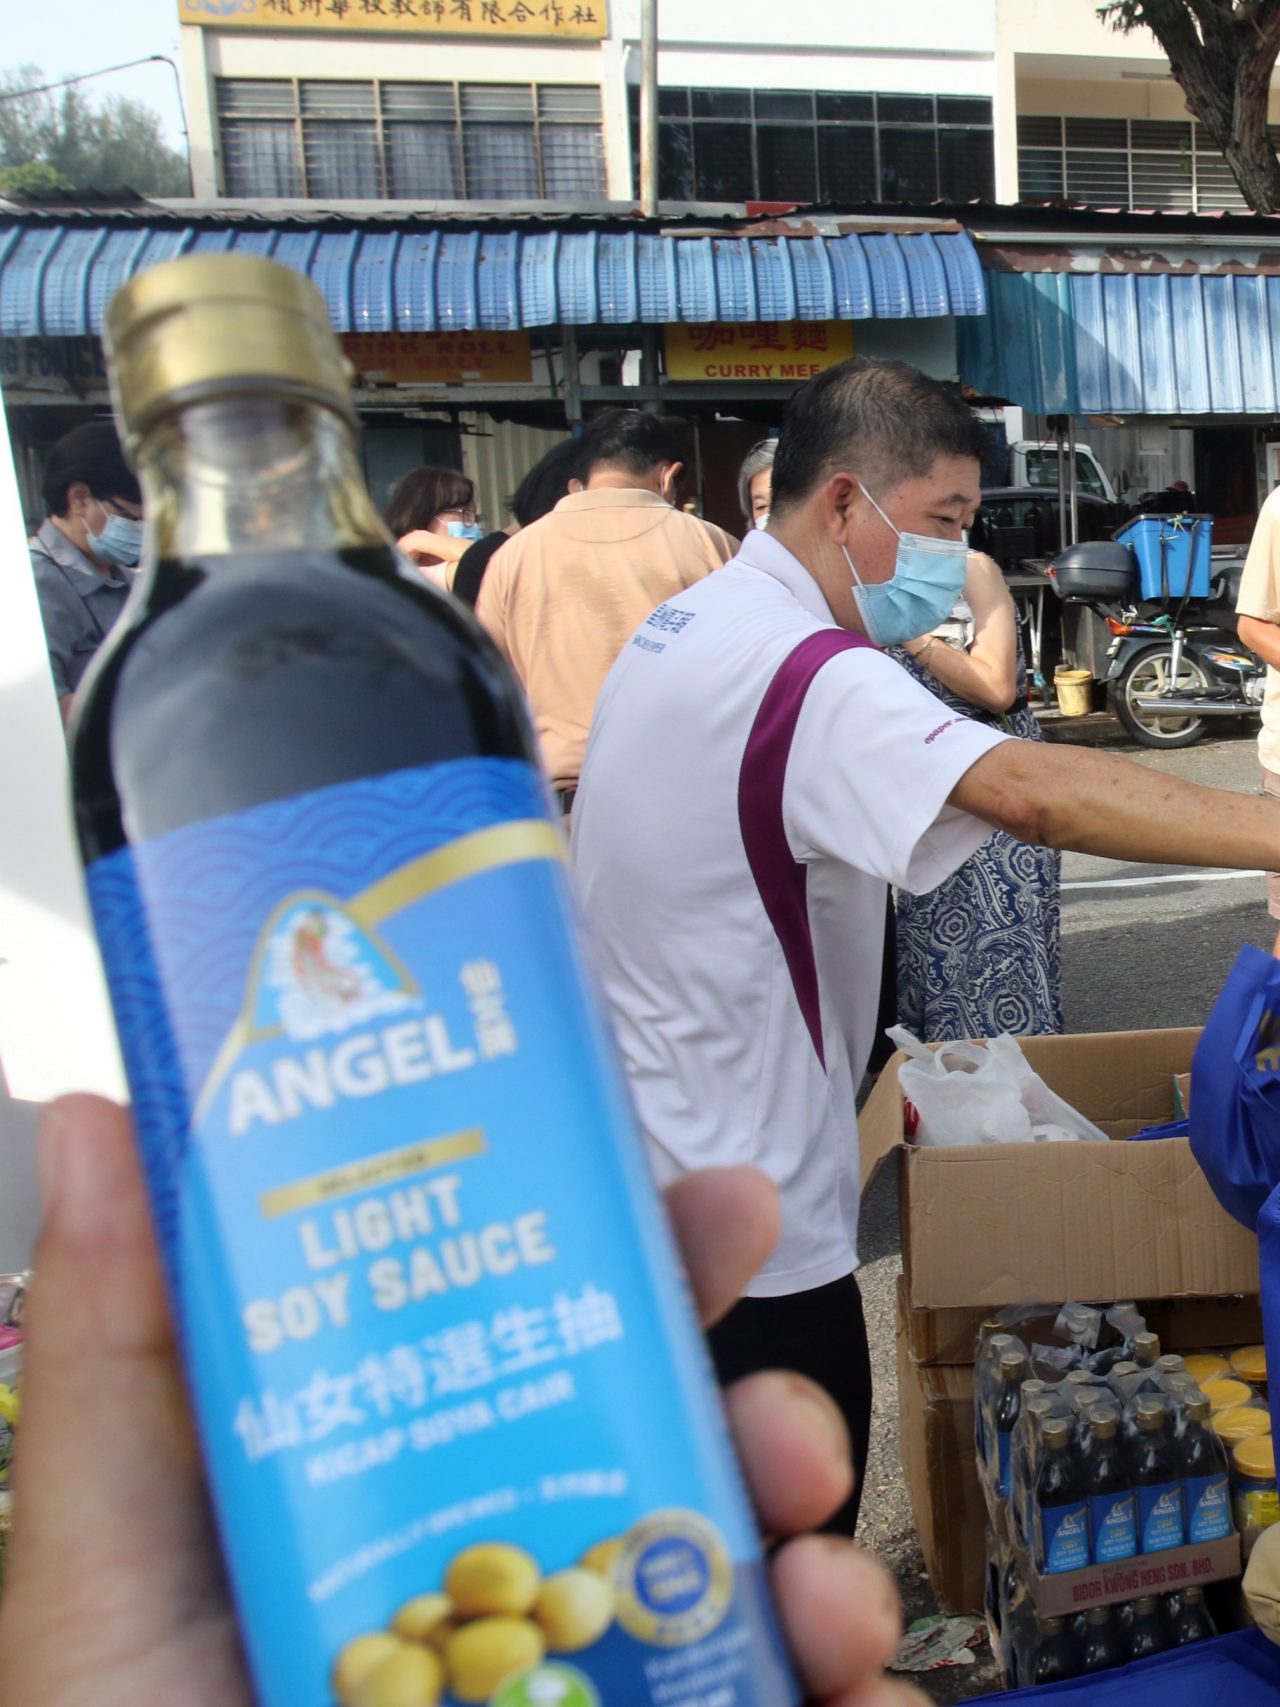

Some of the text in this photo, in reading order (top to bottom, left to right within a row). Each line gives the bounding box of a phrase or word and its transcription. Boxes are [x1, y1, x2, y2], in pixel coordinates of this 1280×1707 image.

[344, 340, 513, 354] RING ROLL
[416, 356, 491, 370] BALL
[704, 364, 821, 377] CURRY MEE
[228, 1013, 477, 1138] ANGEL
[300, 1174, 462, 1270] LIGHT
[242, 1210, 557, 1354] SOY SAUCE
[234, 1282, 625, 1462] 仙女特選生抽
[1072, 1580, 1102, 1602] BIDOR
[1103, 1571, 1138, 1596] KWONG
[1140, 1565, 1165, 1587] HENG
[1168, 1561, 1190, 1582] SDN.
[1192, 1557, 1215, 1576] BHD.
